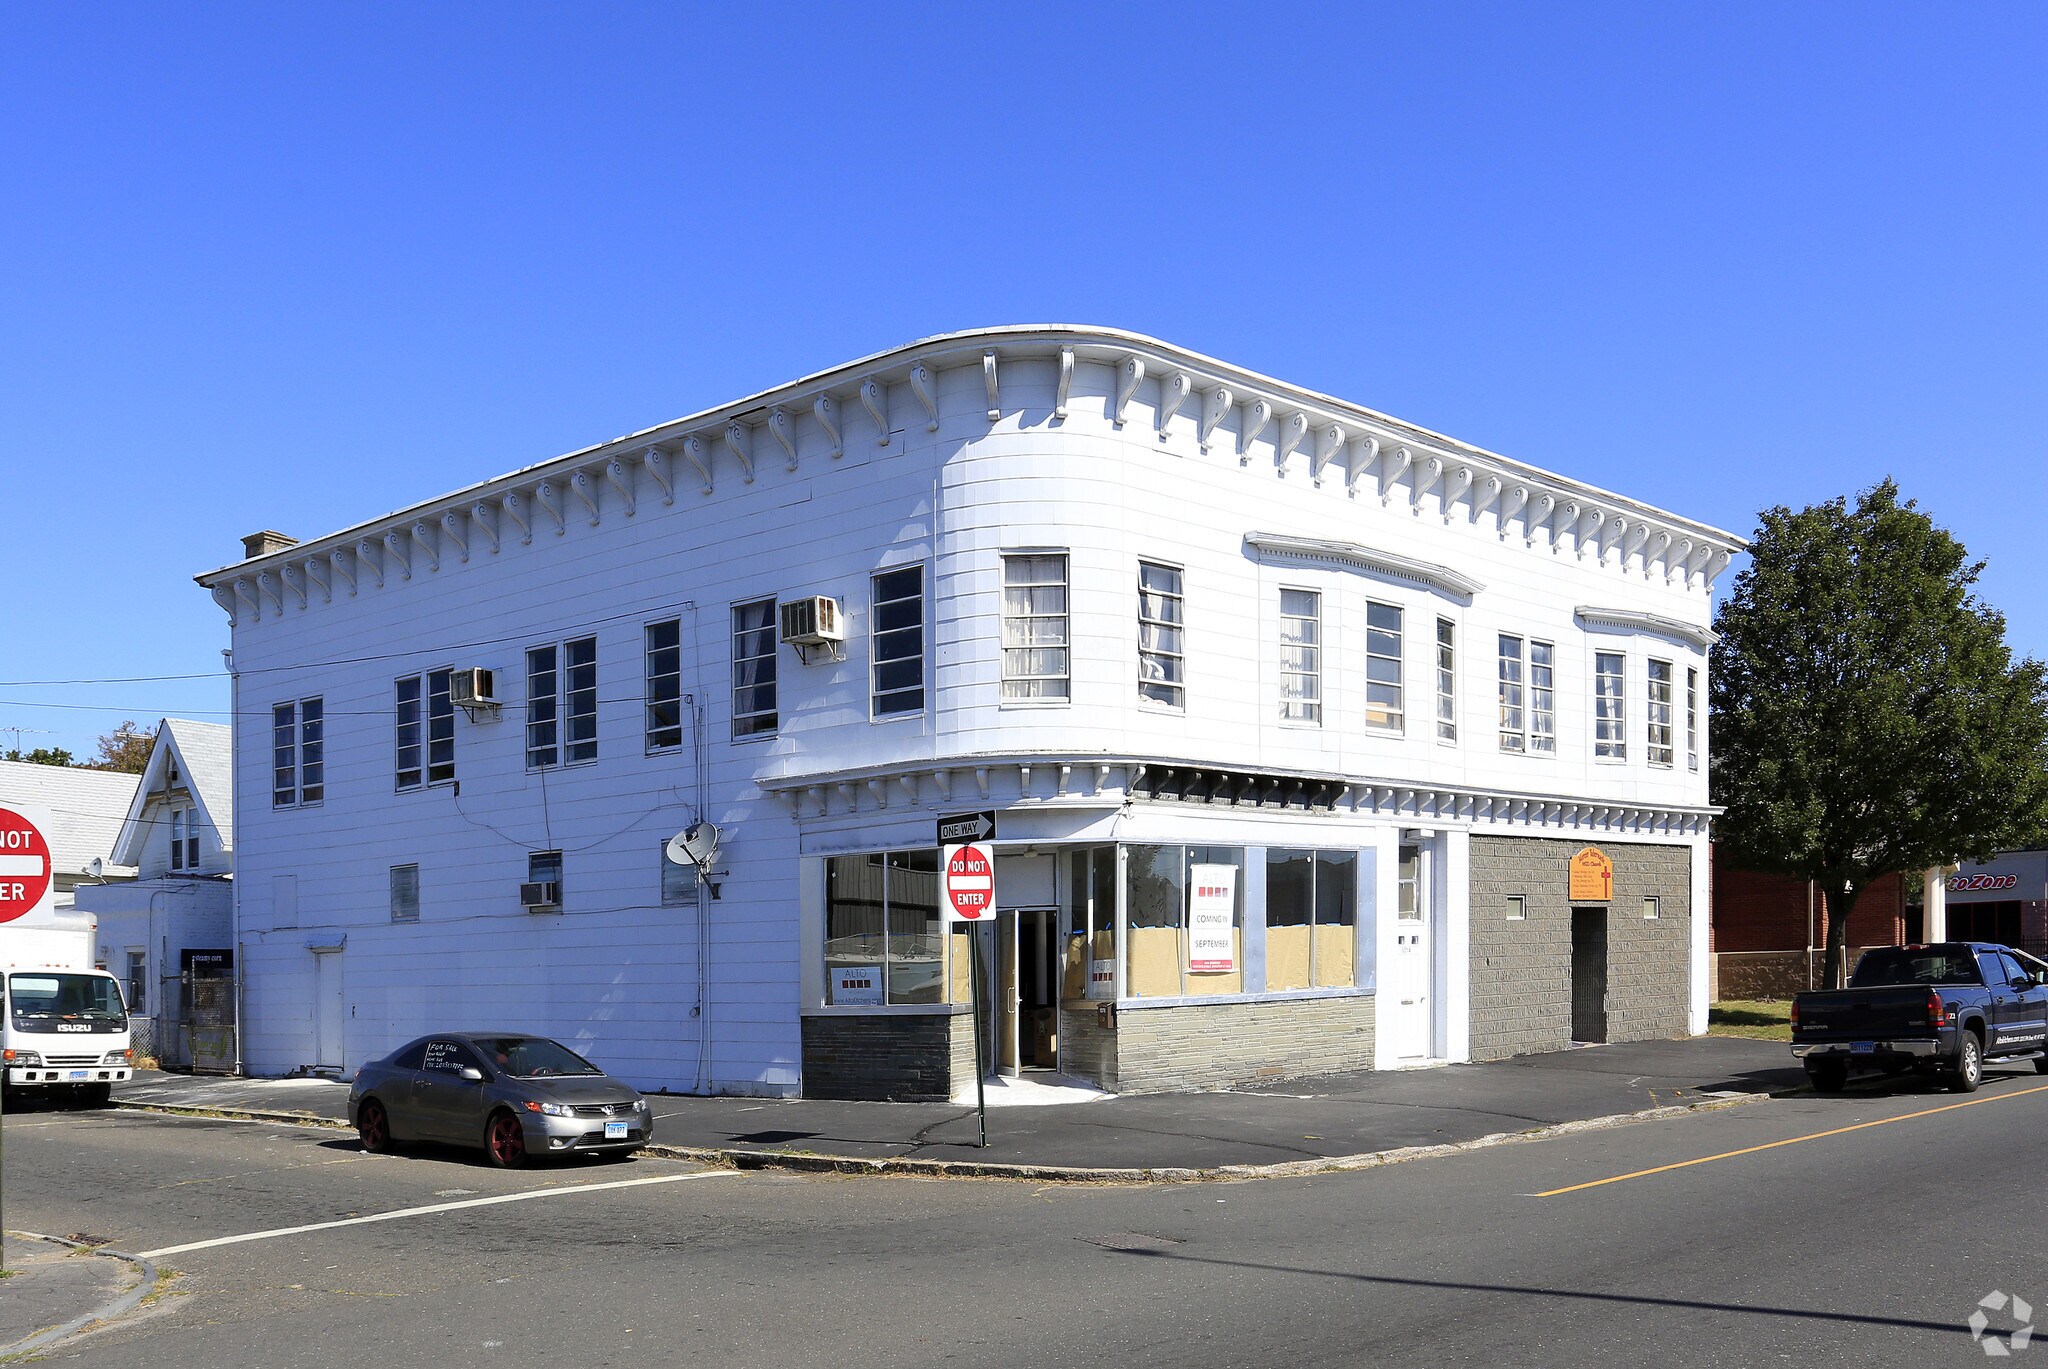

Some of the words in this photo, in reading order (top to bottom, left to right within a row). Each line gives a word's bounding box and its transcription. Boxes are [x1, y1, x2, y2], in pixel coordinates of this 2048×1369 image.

[942, 825, 959, 838] ONE
[960, 821, 978, 835] WAY
[952, 860, 965, 873] DO
[967, 860, 986, 873] NOT
[1202, 872, 1226, 885] ALTO
[957, 893, 985, 906] ENTER
[1196, 914, 1222, 924] COMING
[1222, 915, 1228, 923] IN
[1195, 939, 1229, 948] SEPTEMBER
[1095, 961, 1111, 970] ALTO
[844, 968, 868, 979] ALTO
[57, 1024, 92, 1032] ISUZU
